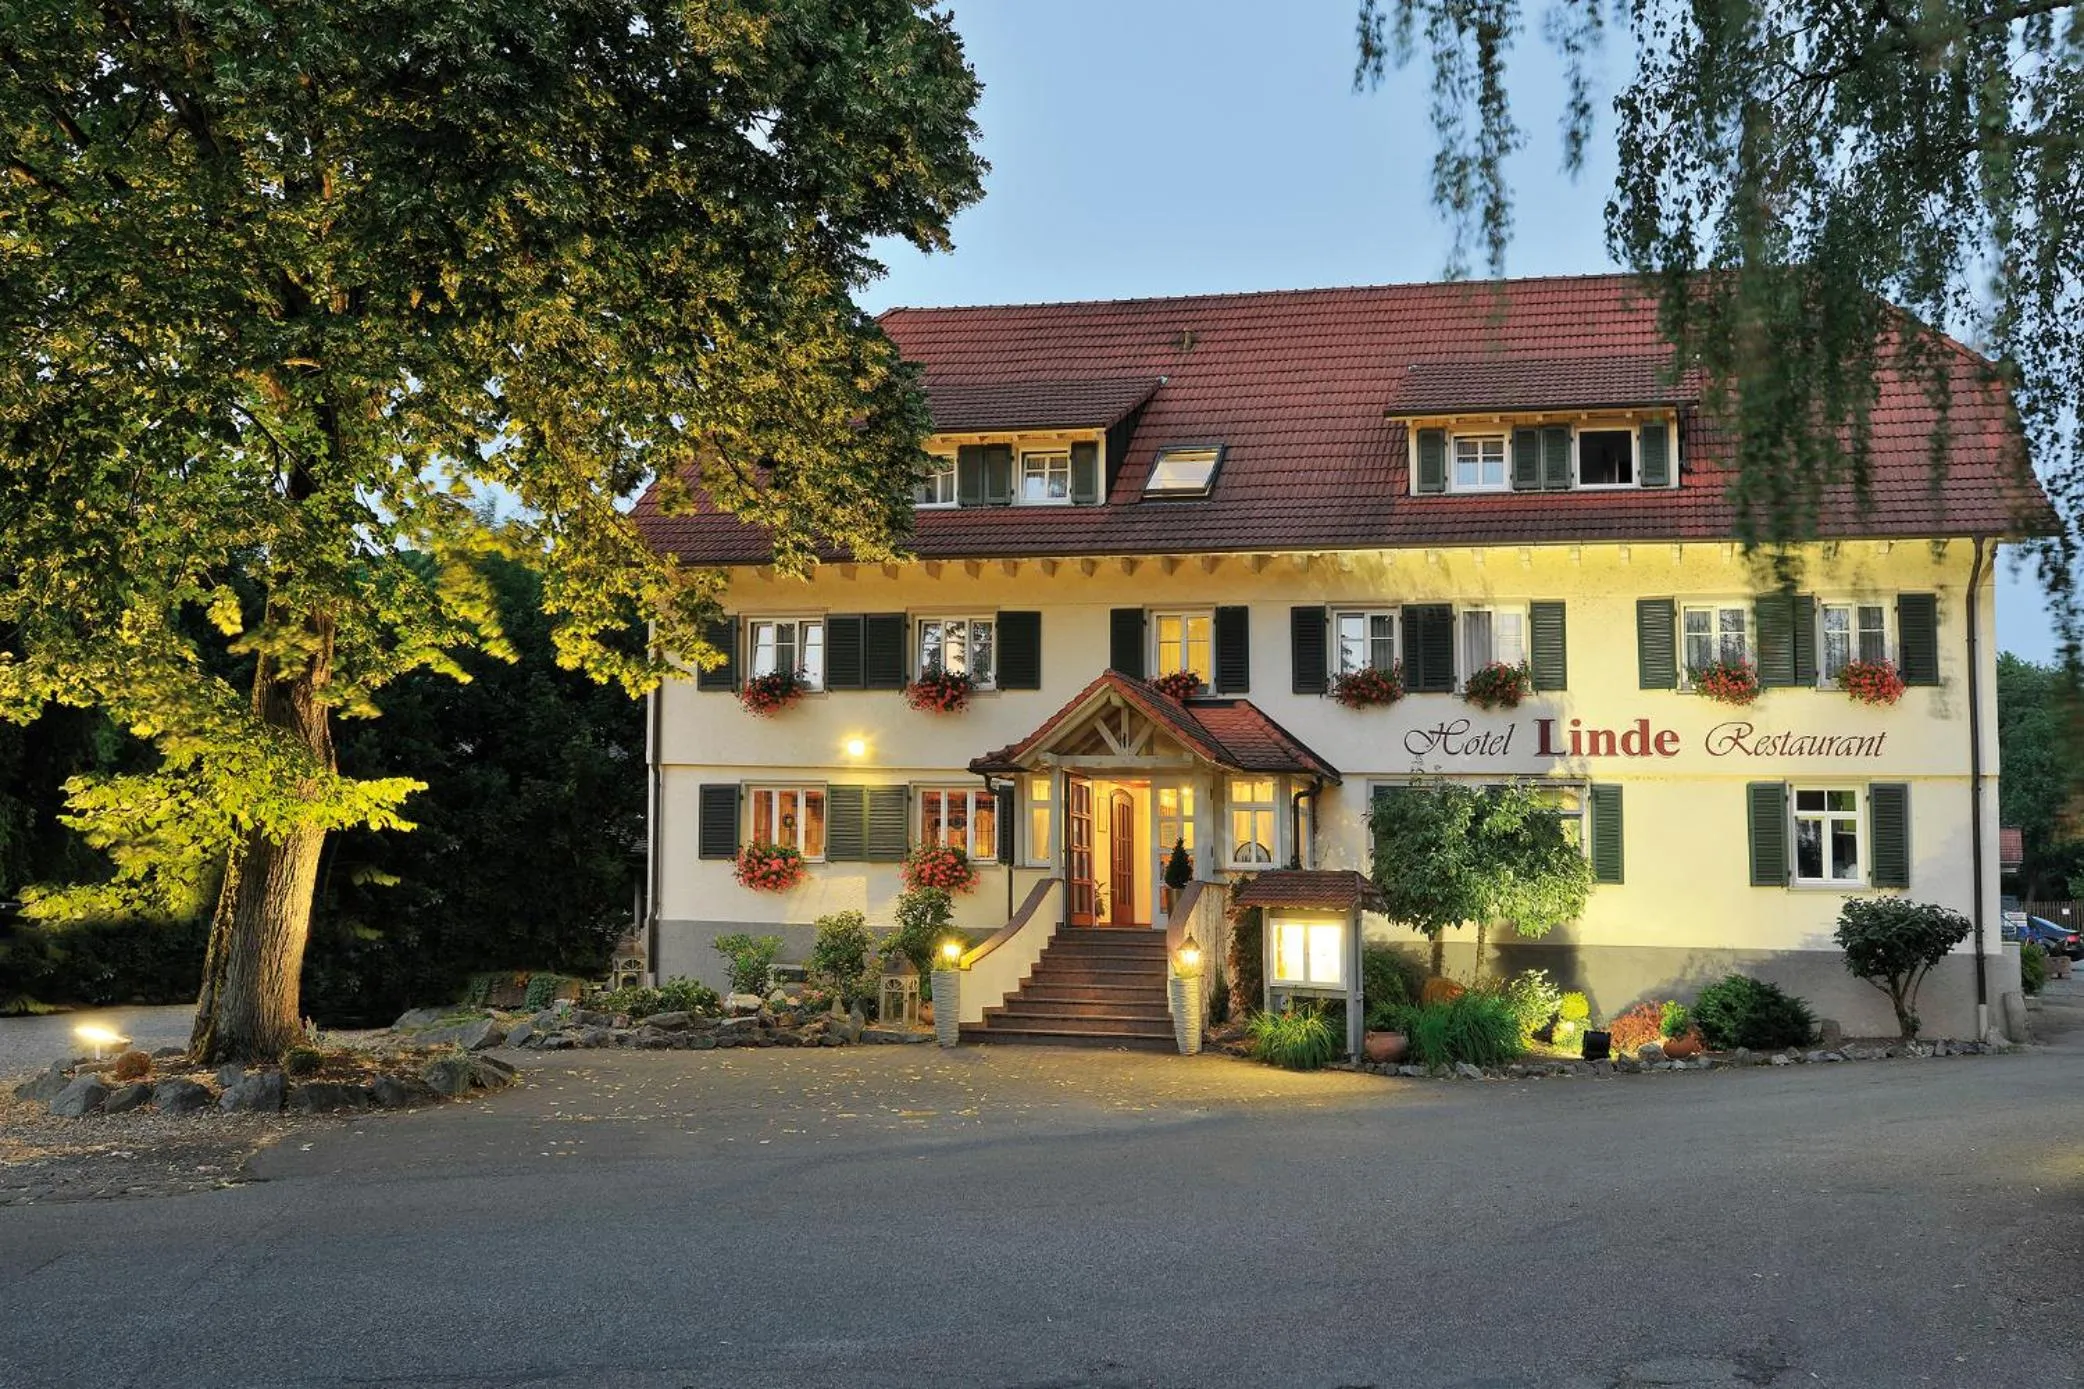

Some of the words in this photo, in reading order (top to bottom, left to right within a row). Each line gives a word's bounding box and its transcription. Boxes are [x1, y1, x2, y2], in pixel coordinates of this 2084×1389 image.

[1404, 719, 1515, 755] Hotel
[1534, 718, 1680, 757] Linde
[1705, 721, 1886, 757] Restaurant
